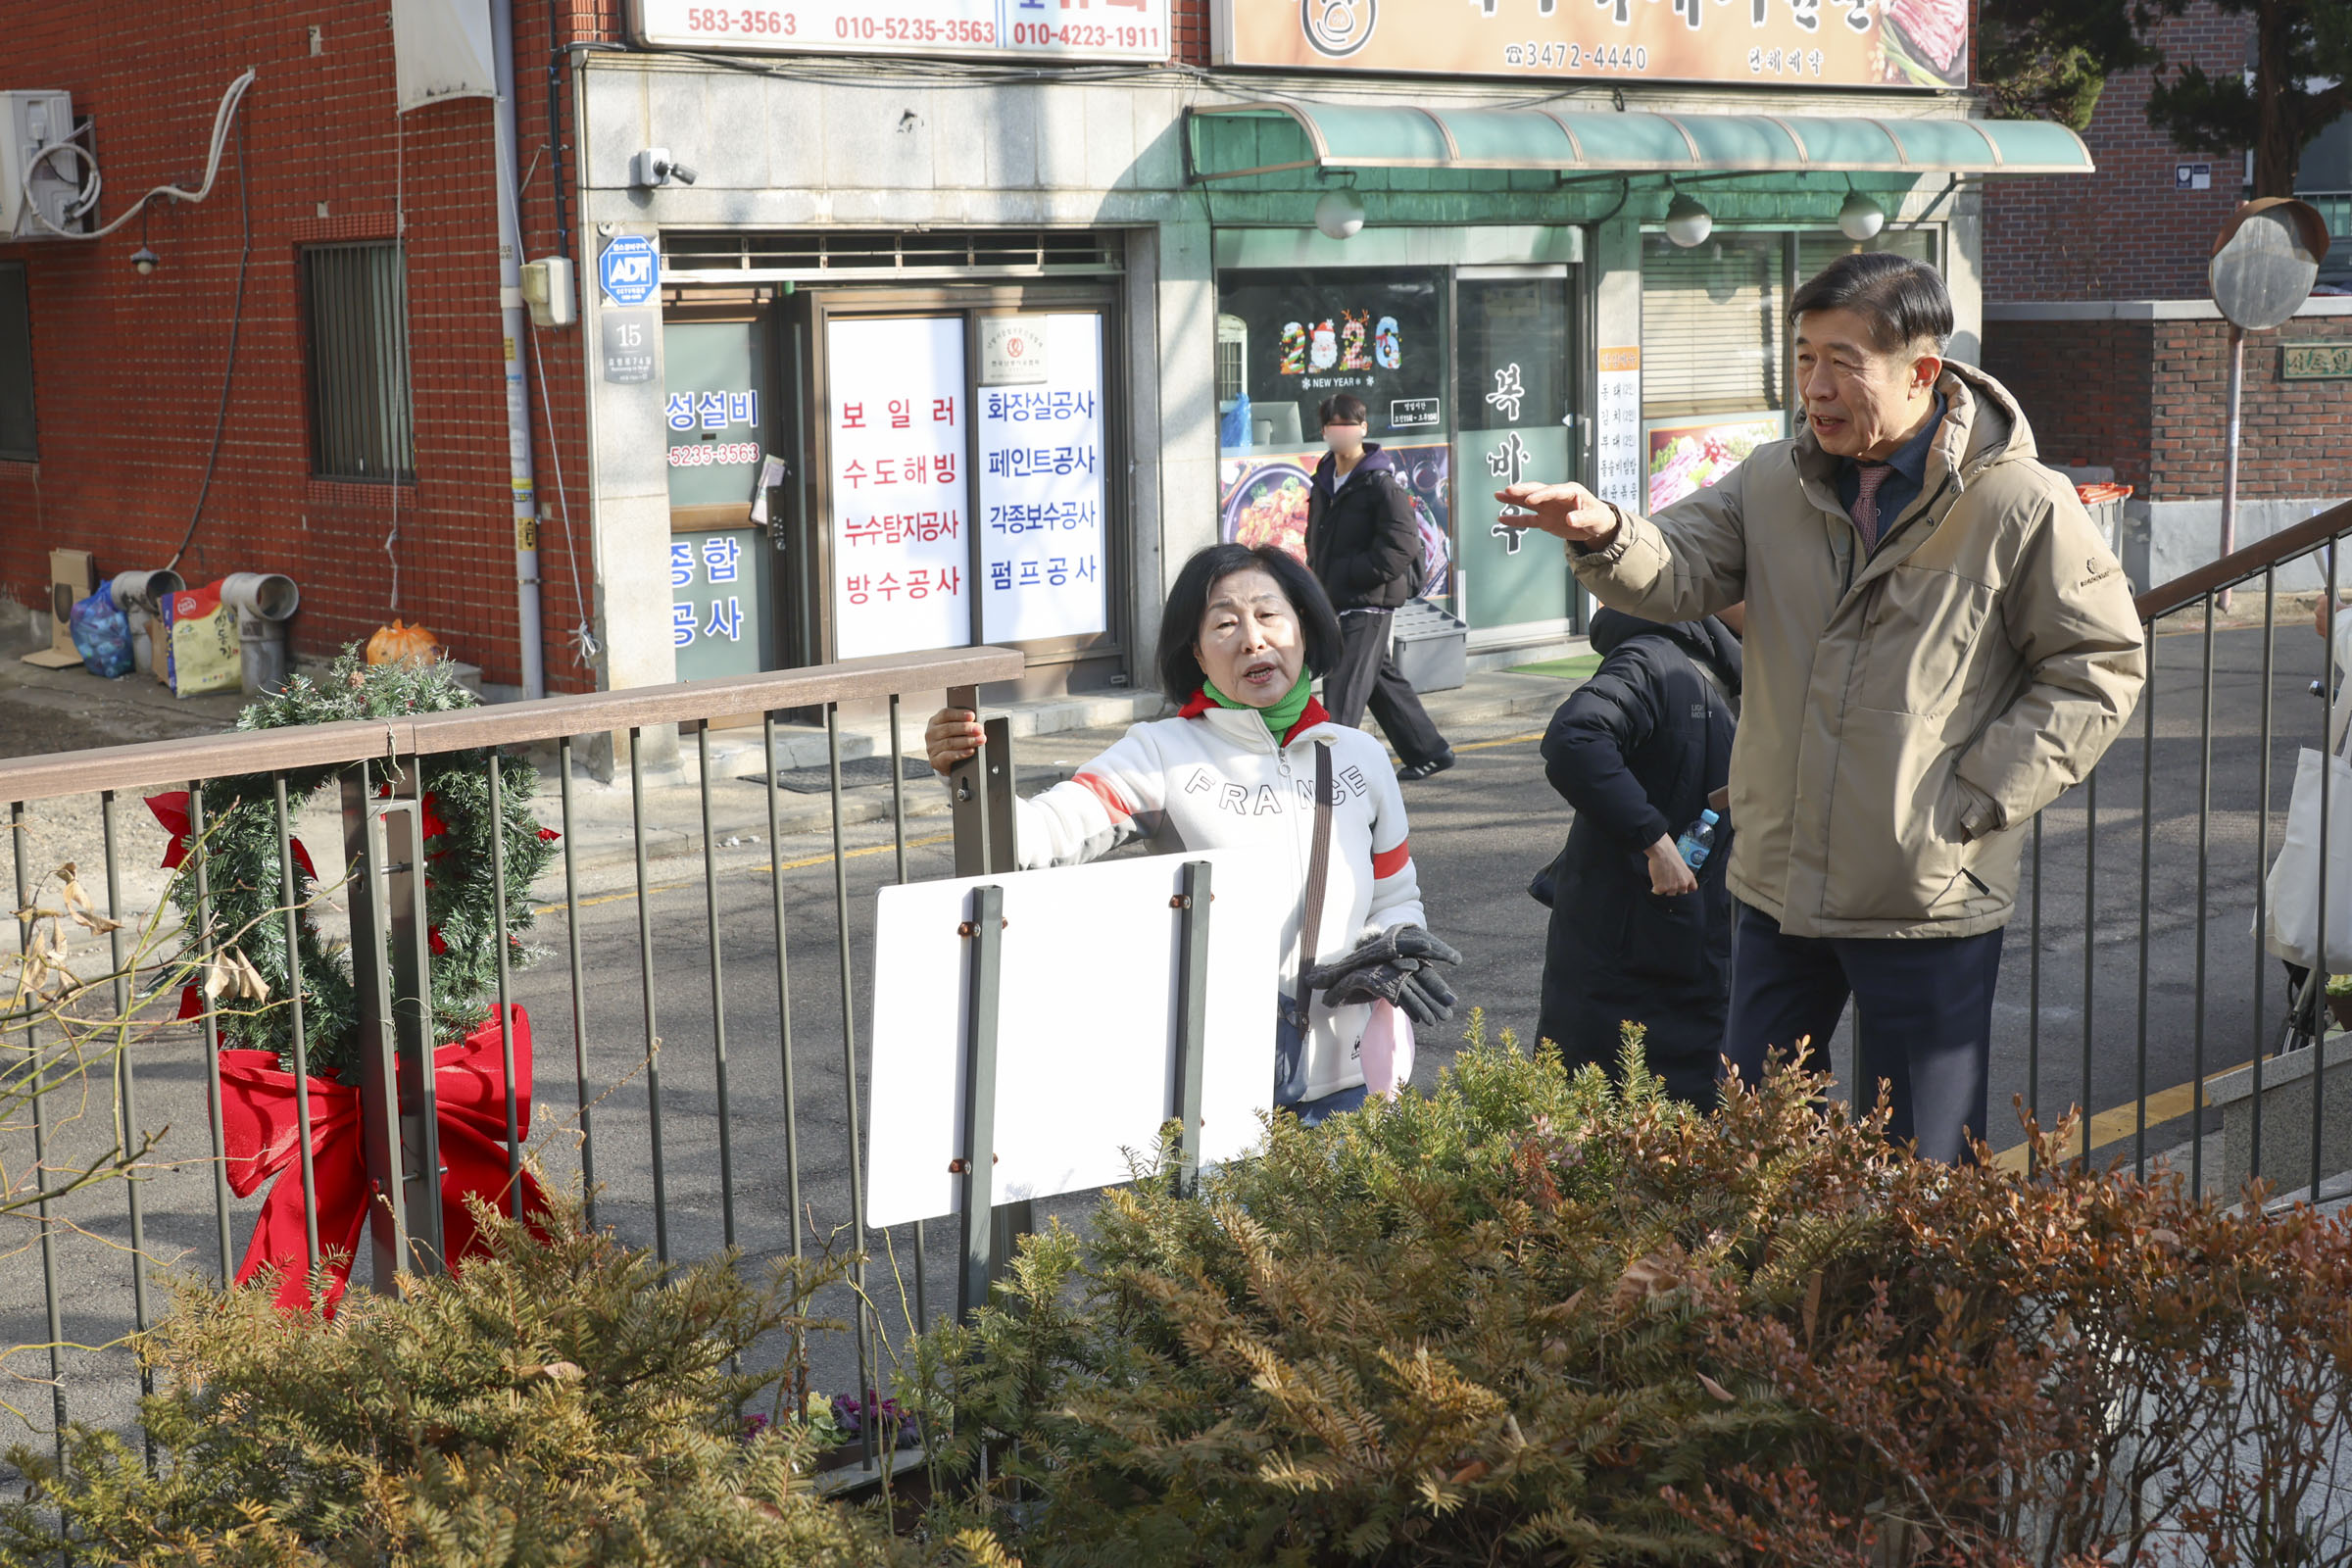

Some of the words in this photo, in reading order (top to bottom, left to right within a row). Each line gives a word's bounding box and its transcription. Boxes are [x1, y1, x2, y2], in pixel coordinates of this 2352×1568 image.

[688, 8, 797, 35] 583-3563
[834, 16, 996, 44] 010-5235-3563
[1013, 22, 1158, 48] 010-4223-1911
[610, 256, 651, 283] ADT
[615, 323, 642, 347] 15
[1312, 377, 1332, 388] NEW
[1333, 376, 1354, 388] YEAR
[665, 389, 758, 431] 성설비
[987, 389, 1096, 422] 화장실공사
[843, 452, 956, 489] 수도해빙
[988, 444, 1096, 478] 페인트공사
[844, 509, 959, 547] 누수탐지공사
[990, 499, 1097, 535] 각종보수공사
[847, 565, 960, 605] 방수공사
[990, 554, 1097, 591] 펌프공사
[1185, 764, 1367, 816] FRANCE
